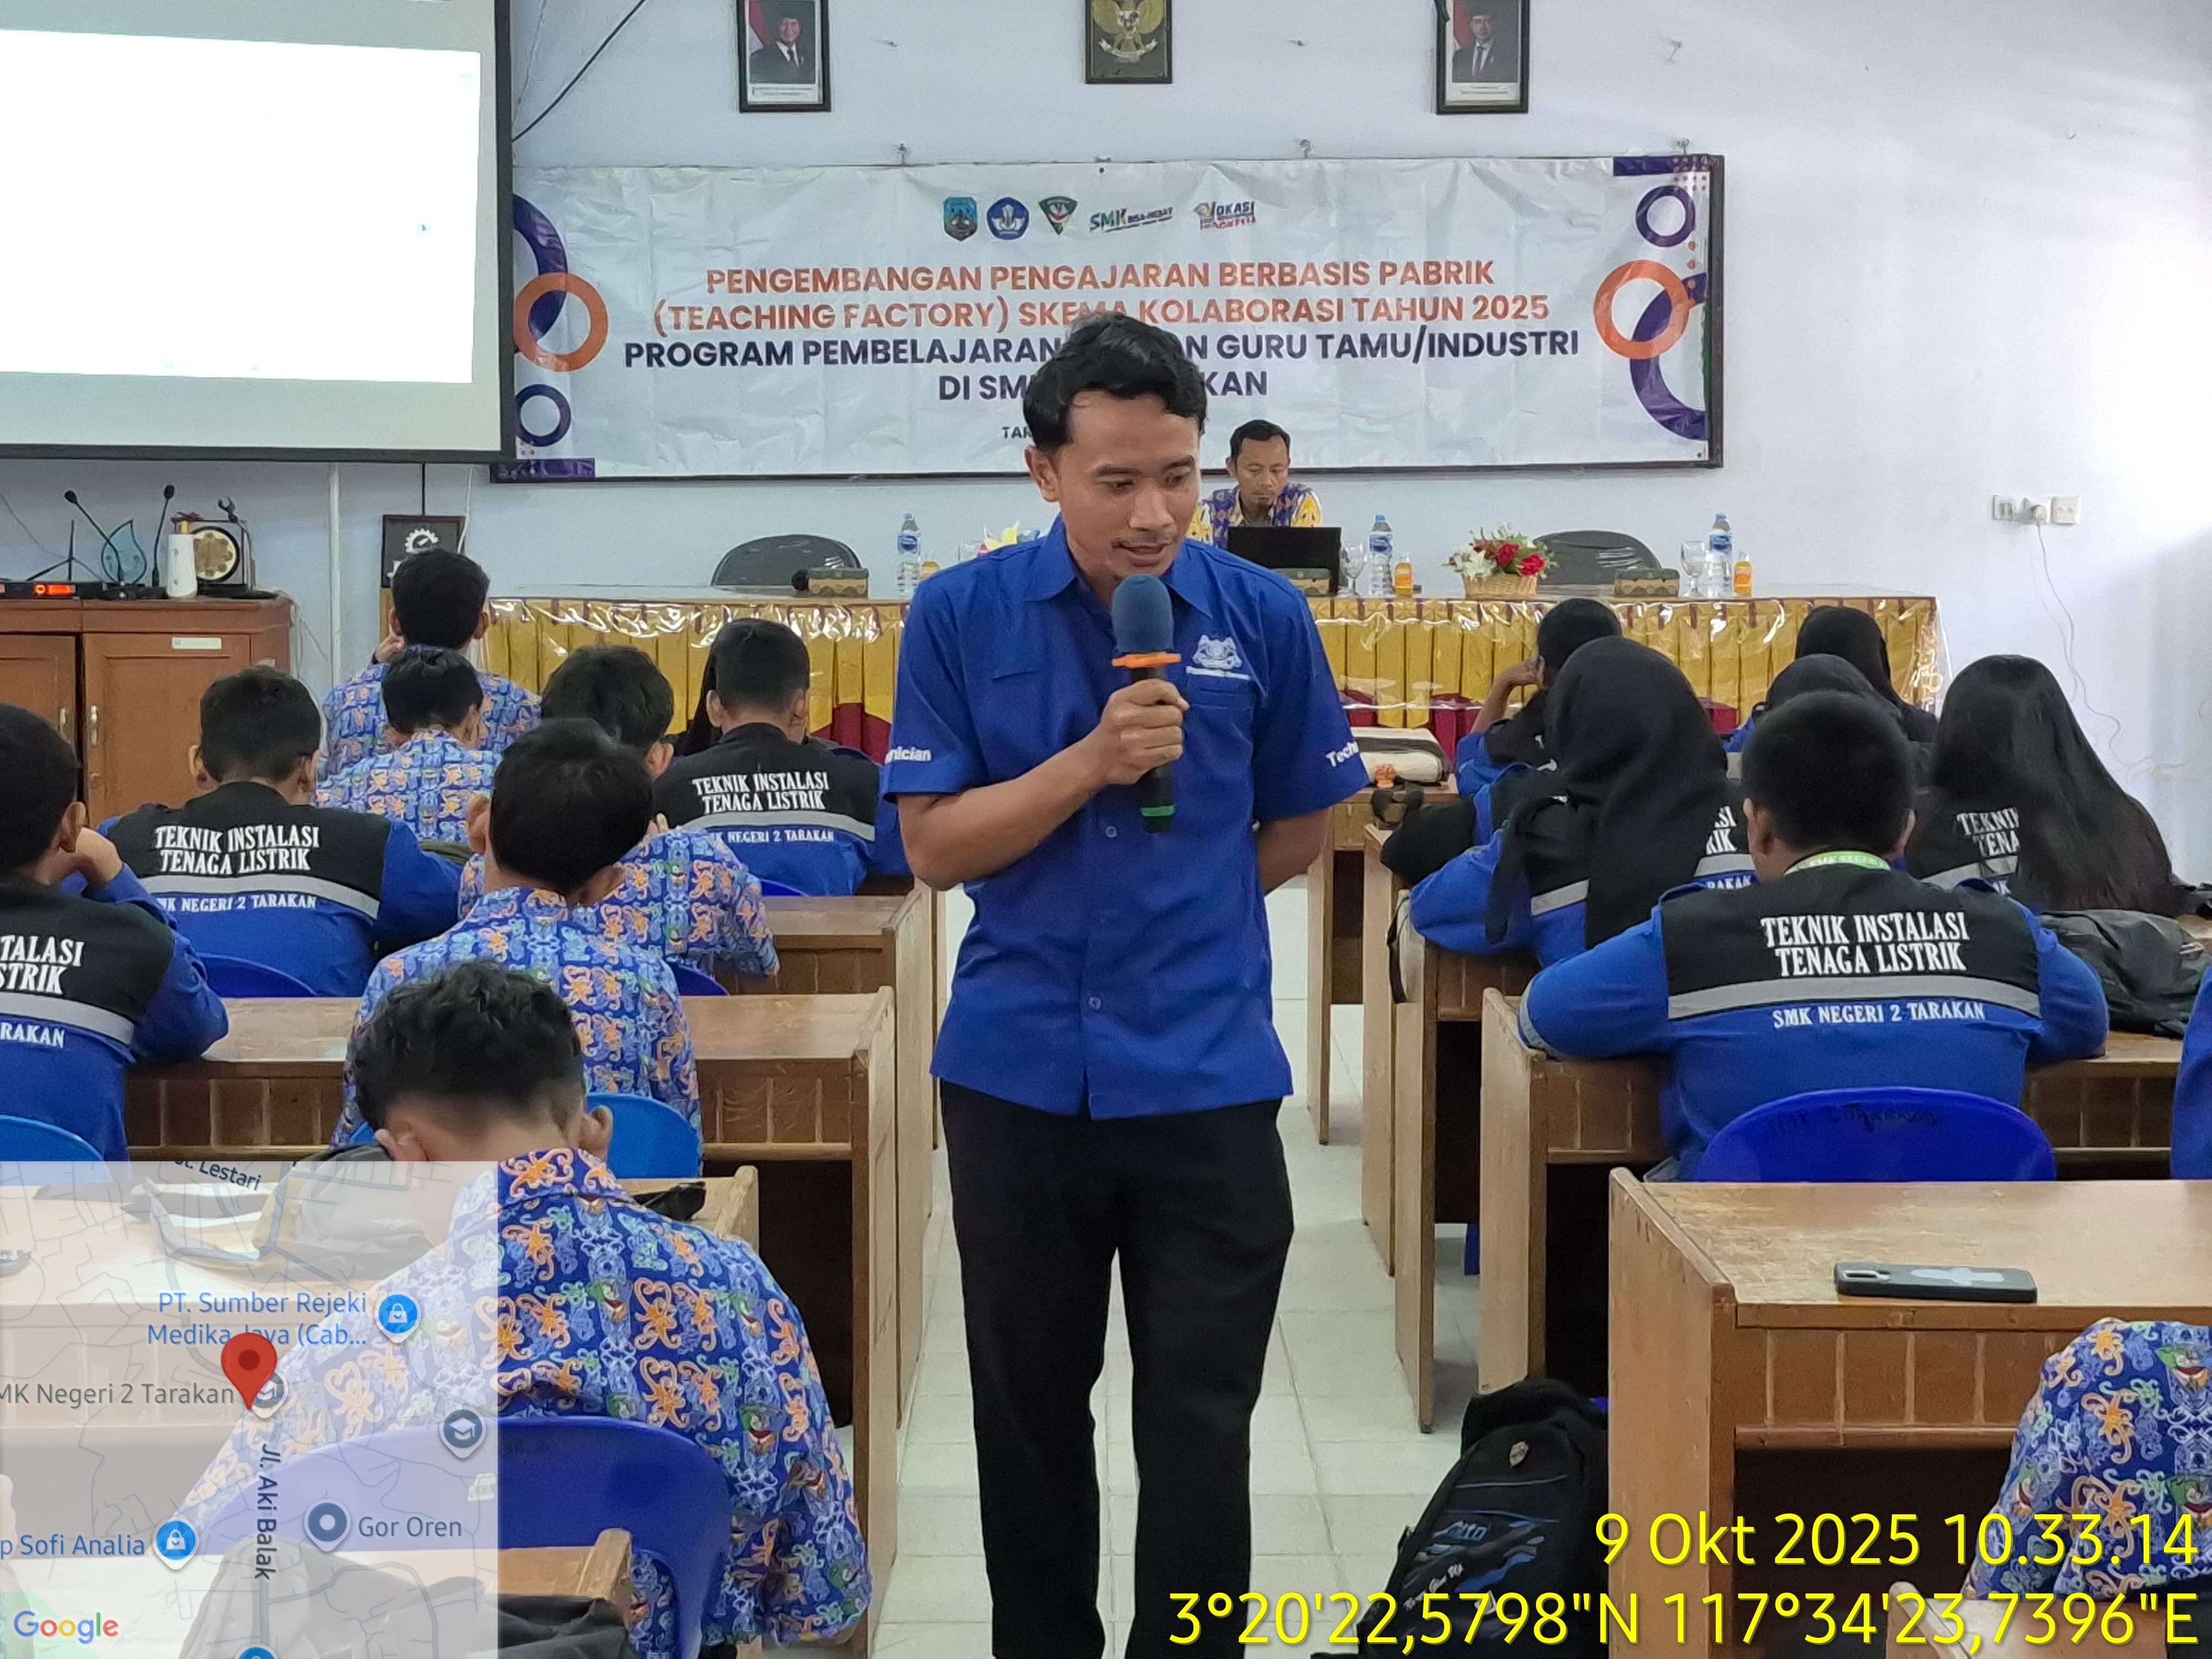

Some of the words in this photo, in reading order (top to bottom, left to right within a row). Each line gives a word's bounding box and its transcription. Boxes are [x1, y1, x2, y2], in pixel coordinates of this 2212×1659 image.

[1090, 209, 1127, 231] SMK
[707, 267, 981, 294] PENGEMBANGAN
[991, 263, 1209, 291] PENGAJARAN
[1219, 261, 1369, 287] BERBASIS
[1380, 260, 1494, 286] PABRIK
[654, 299, 835, 338] (TEACHING
[844, 297, 1009, 333] FACTORY)
[1140, 297, 1344, 324] KOLABORASI
[1352, 295, 1464, 321] TAHUN
[1472, 294, 1550, 320] 2025
[625, 340, 793, 369] PROGRAM
[803, 337, 1062, 366] PEMBELAJARAN
[1223, 334, 1307, 361] GURU
[1315, 325, 1579, 364] TAMU/INDUSTRI
[939, 375, 970, 401] DI
[692, 775, 750, 796] TEKNIK
[755, 771, 829, 792] INSTALASI
[703, 793, 763, 814] TENAGA
[768, 791, 826, 812] LISTRIK
[155, 825, 222, 853] TEKNIK
[228, 824, 320, 852] INSTALASI
[728, 831, 769, 843] NEGERI
[773, 830, 781, 842] 2
[785, 829, 834, 842] TARAKAN
[161, 850, 233, 876] TENAGA
[240, 848, 311, 872] LISTRIK
[181, 897, 233, 912] NEGERI
[235, 896, 247, 910] 2
[251, 893, 318, 910] TARAKAN
[1760, 915, 1848, 948] TEKNIK
[1854, 911, 1972, 943] INSTALASI
[0, 934, 86, 967] TALASI
[1775, 944, 1870, 977] TENAGA
[1876, 941, 1967, 972] LISTRIK
[0, 962, 68, 995] STRIK
[1772, 1008, 1813, 1030] SMK
[1818, 1004, 1885, 1025] NEGERI
[1891, 1003, 1902, 1023] 2
[1907, 1000, 1986, 1021] TARAKAN
[0, 1022, 65, 1049] RAKAN
